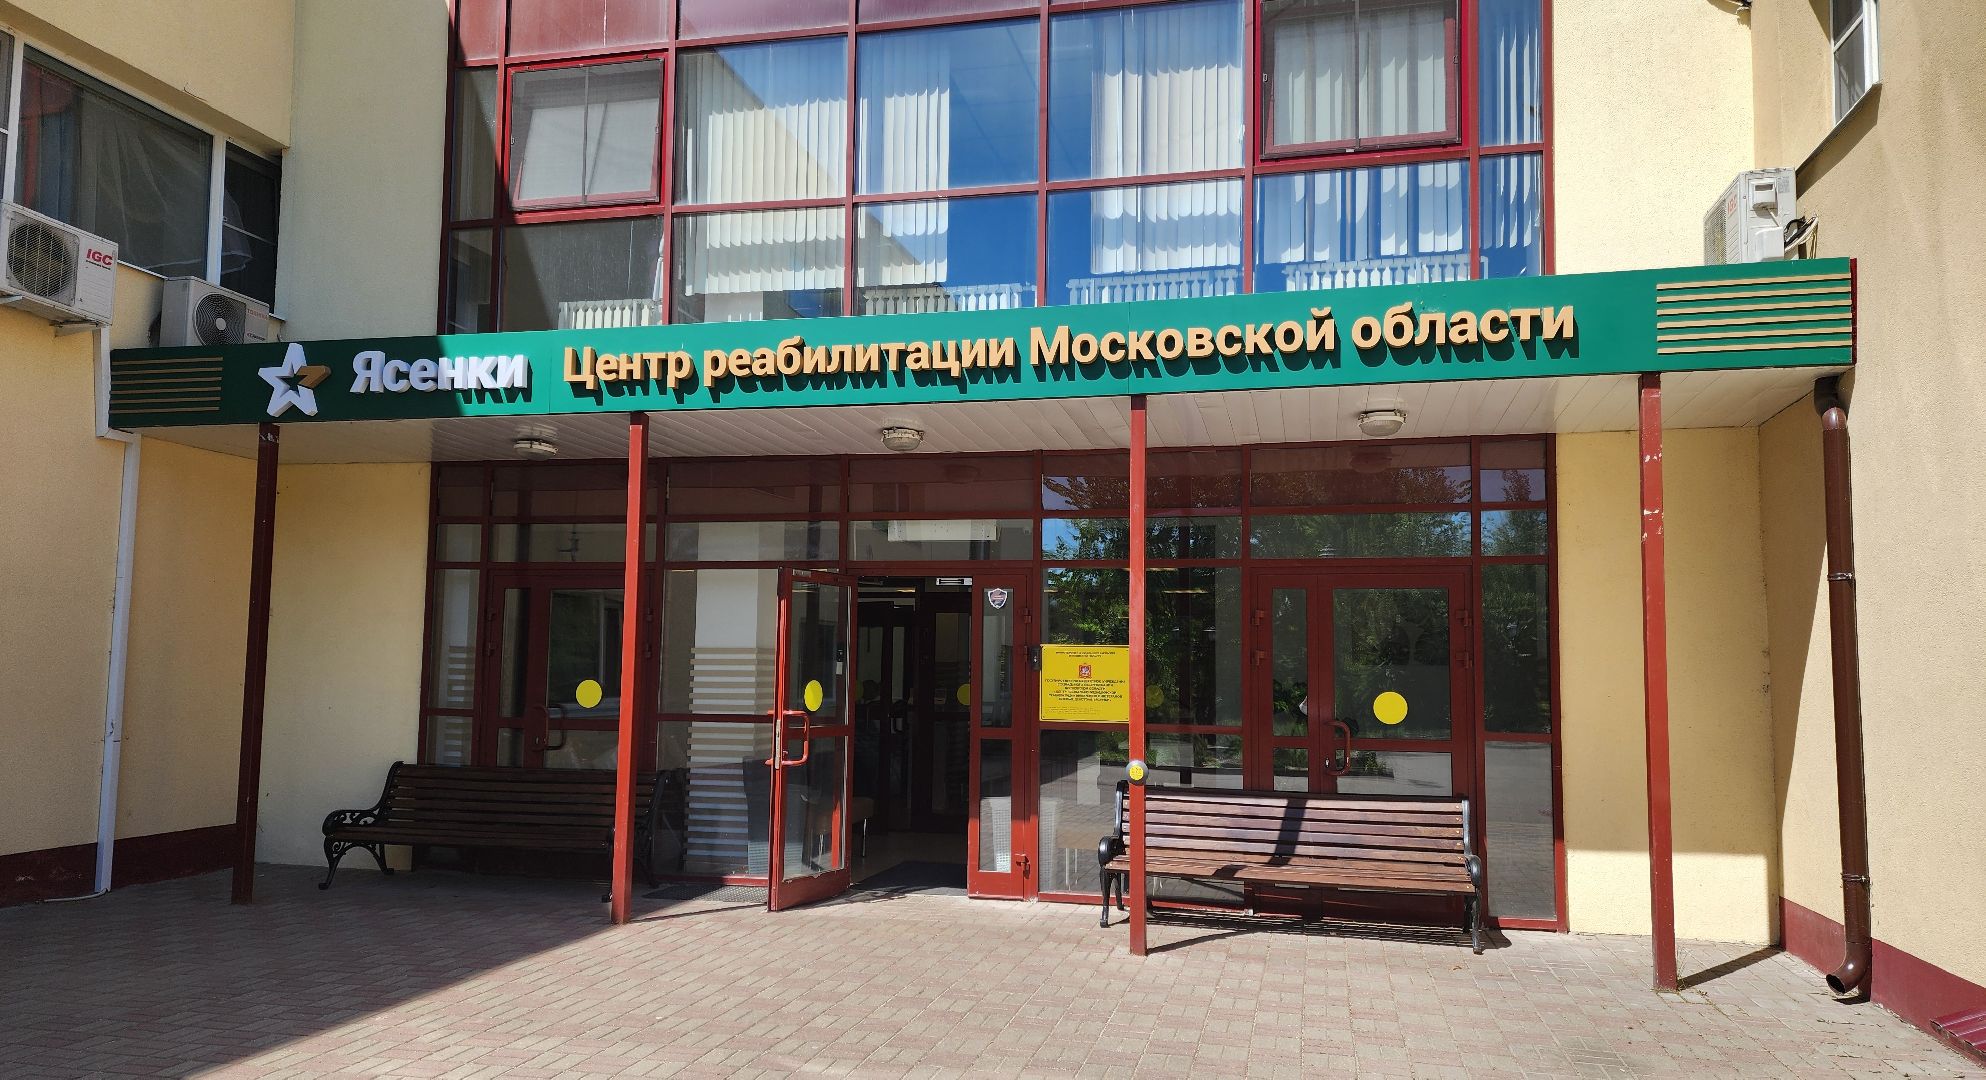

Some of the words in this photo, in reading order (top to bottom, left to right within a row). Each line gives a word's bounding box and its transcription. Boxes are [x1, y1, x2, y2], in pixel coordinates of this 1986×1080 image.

[86, 248, 113, 266] IGC
[563, 346, 698, 391] Центр
[703, 335, 1016, 388] реабилитации
[1029, 306, 1337, 367] Московской
[1351, 301, 1576, 350] области
[350, 349, 528, 394] Ясенки
